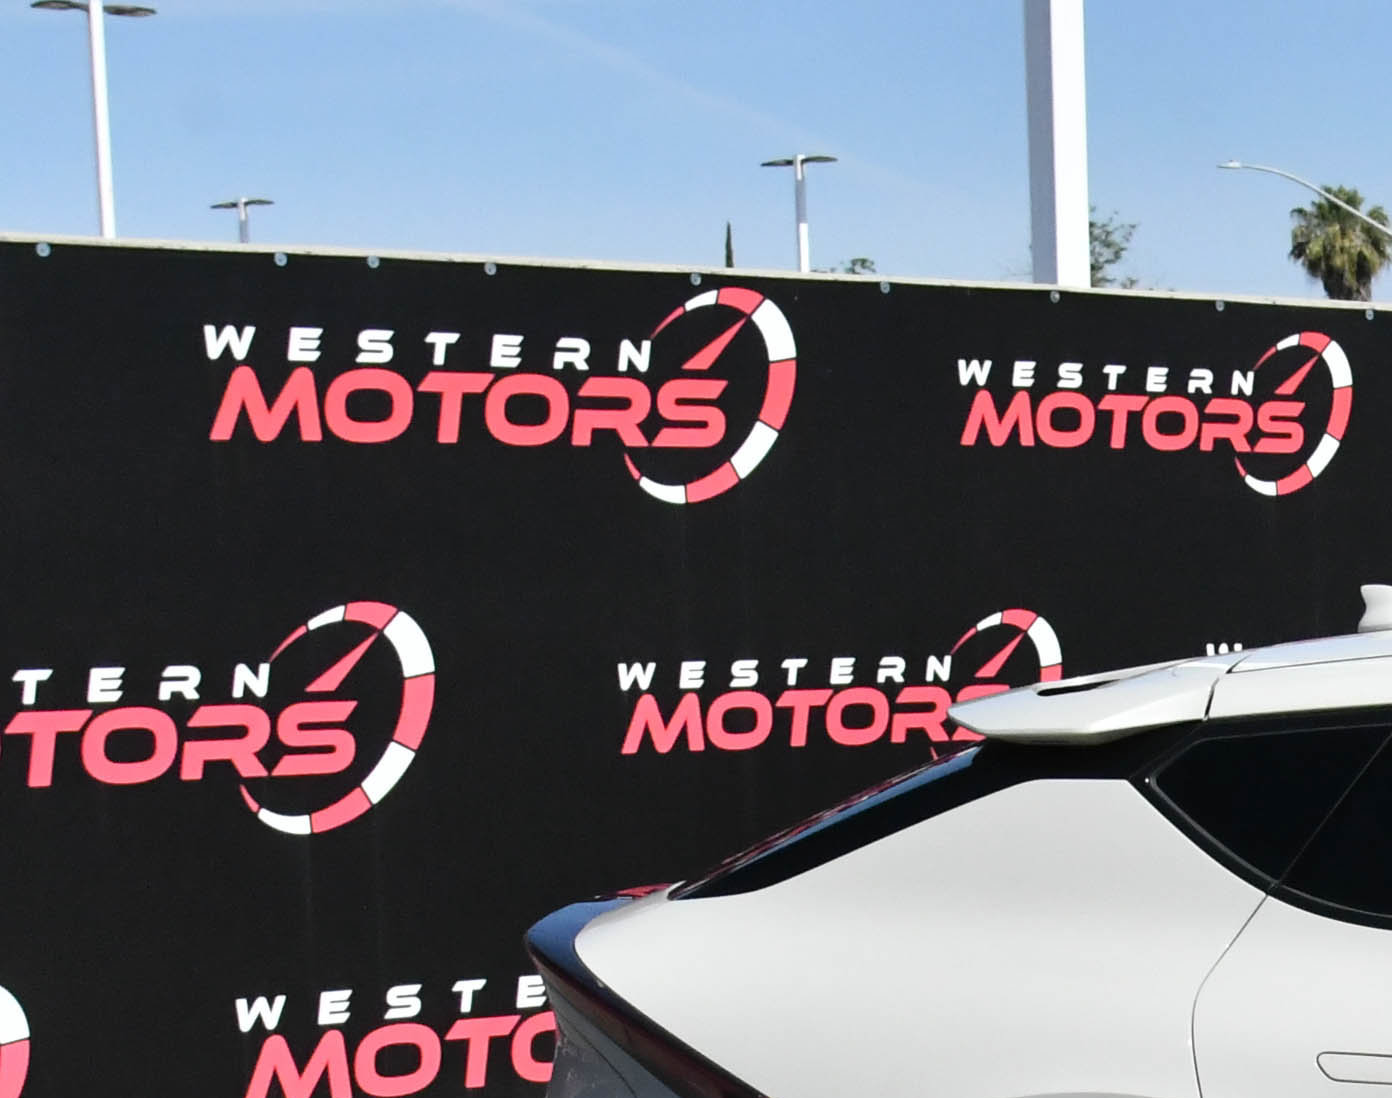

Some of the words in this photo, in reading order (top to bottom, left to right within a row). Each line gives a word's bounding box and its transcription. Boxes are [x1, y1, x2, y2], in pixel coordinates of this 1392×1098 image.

[203, 324, 652, 373] WESTERN
[957, 359, 1255, 396] WESTERN
[209, 365, 729, 448] MOTORS
[960, 389, 1306, 454] MOTORS
[12, 662, 271, 705] TERN
[617, 654, 952, 692] WESTERN
[0, 700, 358, 788] TORS
[235, 974, 549, 1033] WESTE
